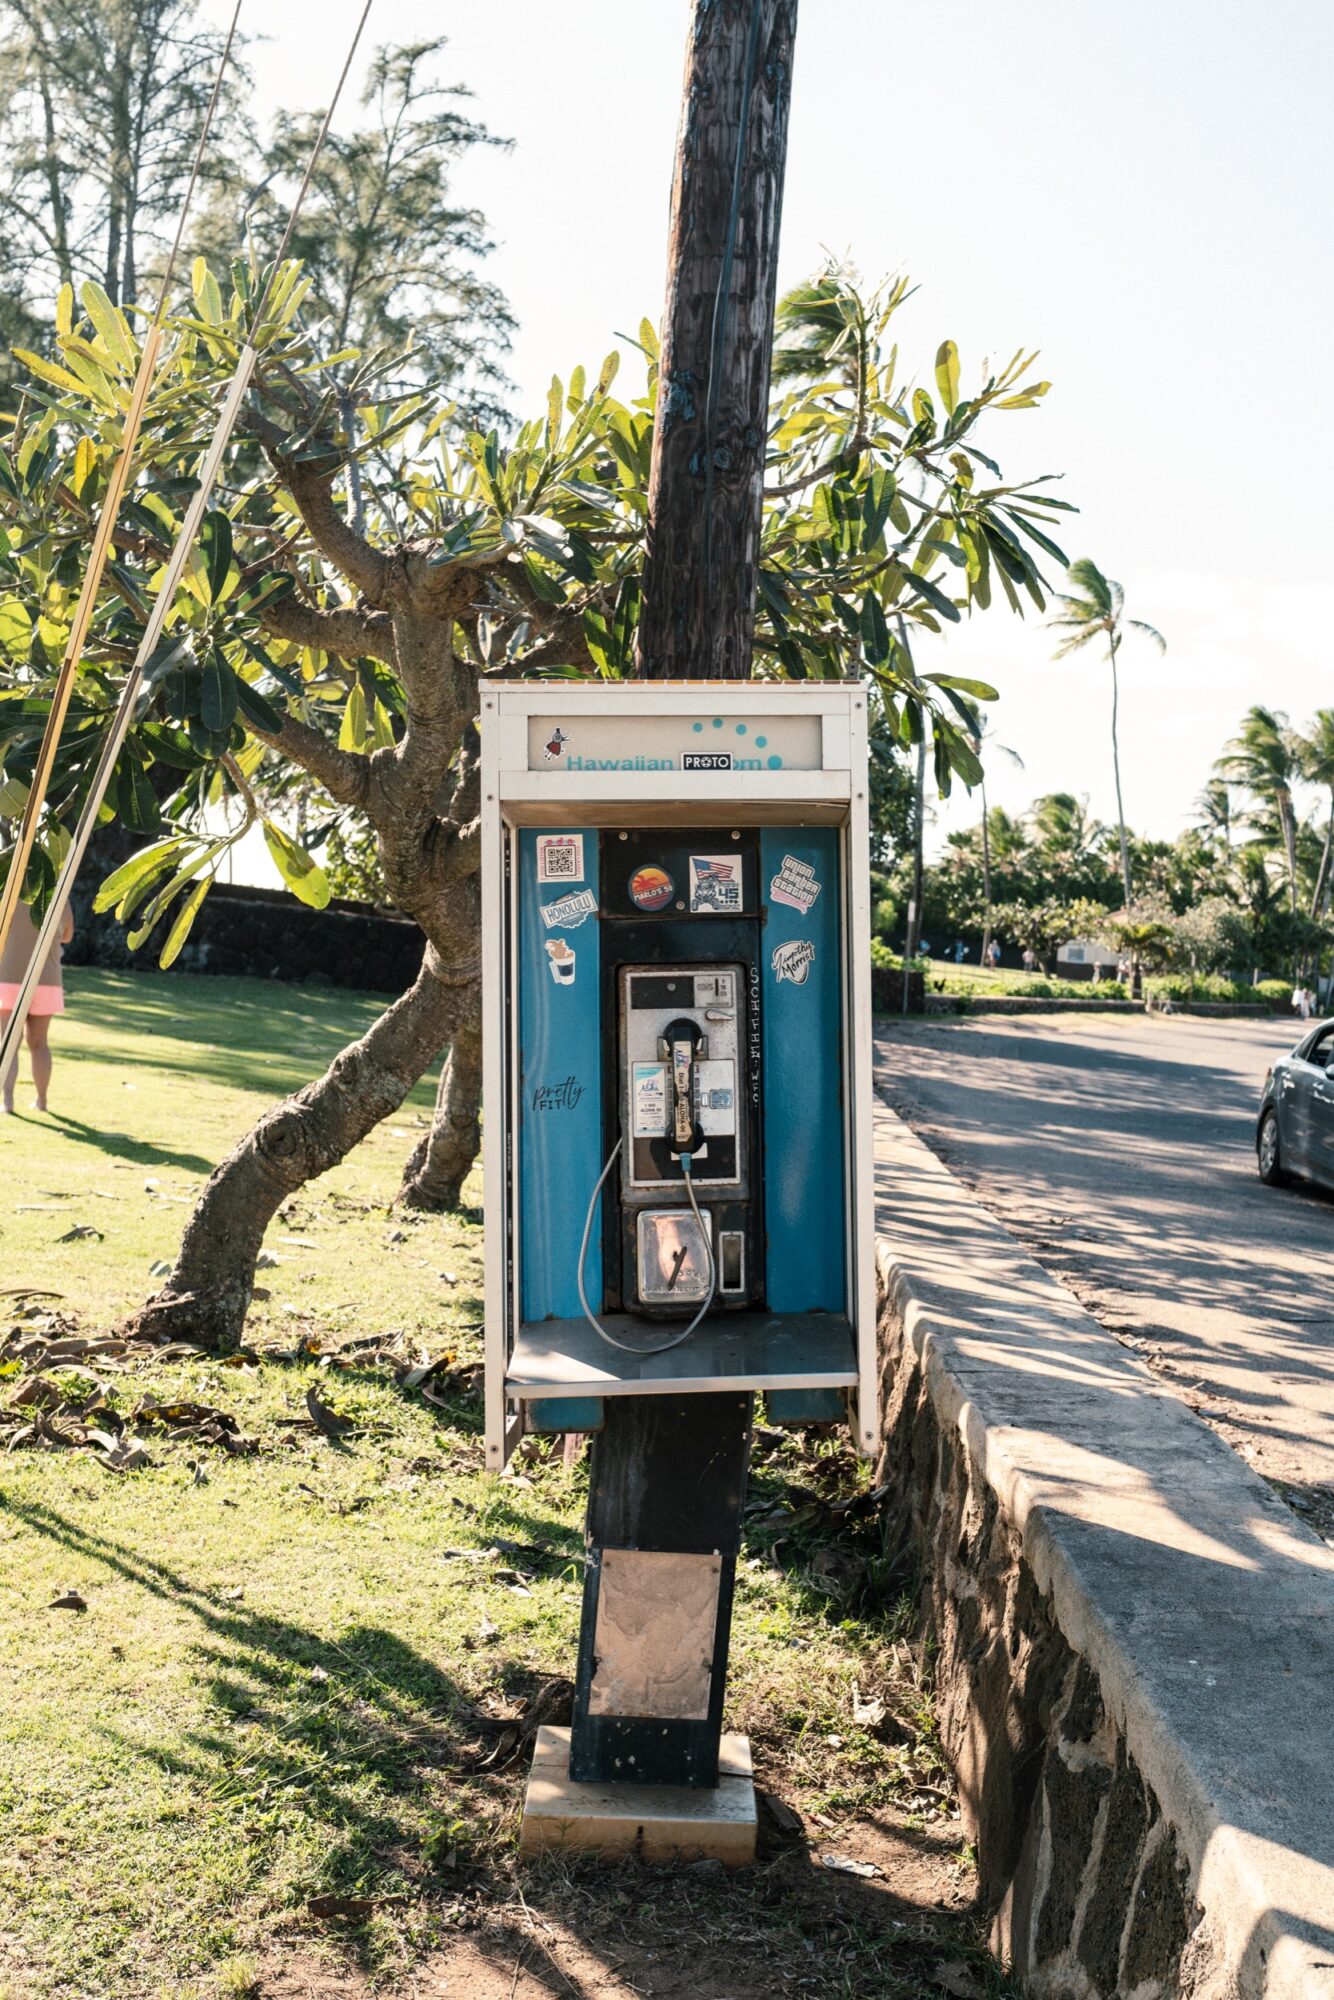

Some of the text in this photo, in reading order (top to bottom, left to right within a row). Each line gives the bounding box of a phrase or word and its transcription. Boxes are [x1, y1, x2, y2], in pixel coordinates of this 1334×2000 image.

[566, 755, 673, 770] Hawaiian
[685, 756, 729, 768] PROTO
[718, 887, 739, 899] 45
[546, 894, 591, 922] HONOLULU
[781, 952, 809, 978] Morris
[540, 1099, 562, 1110] FIT
